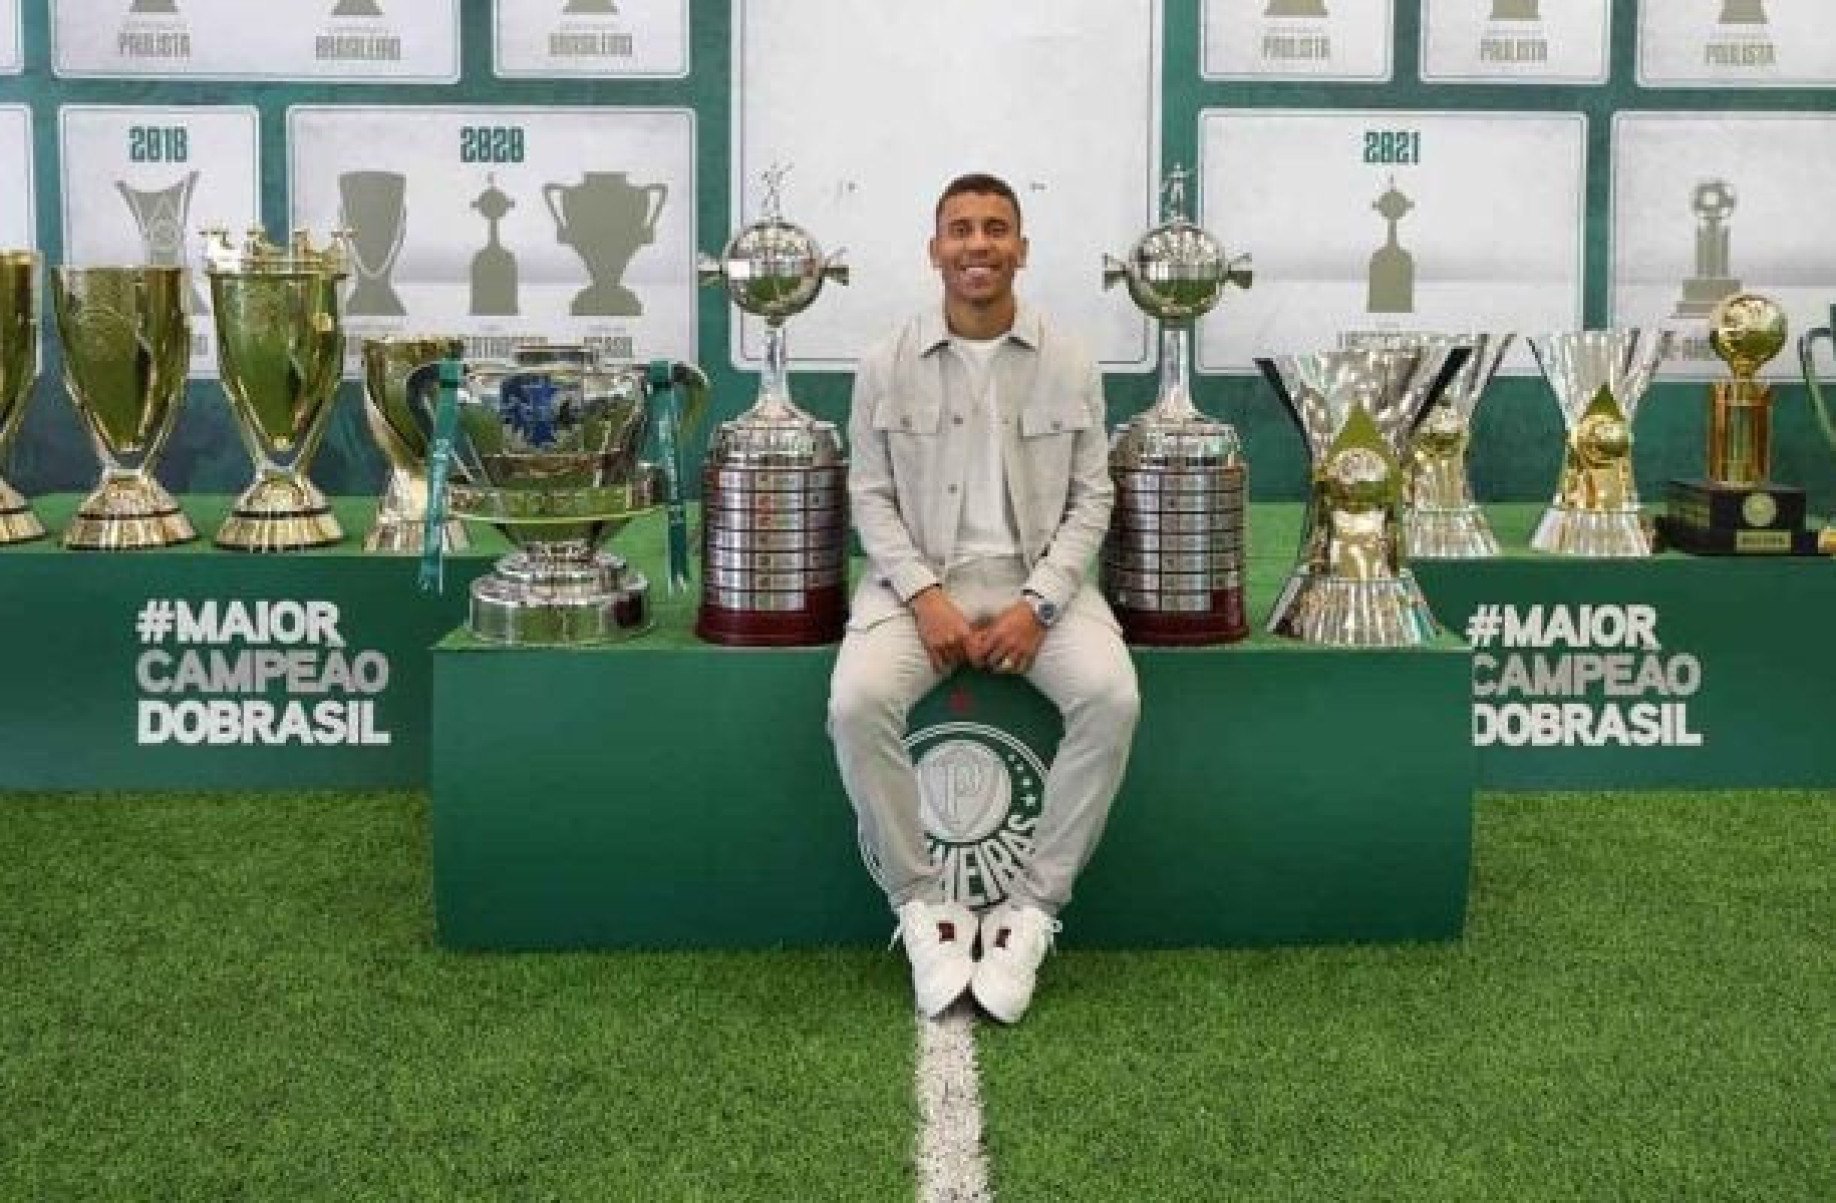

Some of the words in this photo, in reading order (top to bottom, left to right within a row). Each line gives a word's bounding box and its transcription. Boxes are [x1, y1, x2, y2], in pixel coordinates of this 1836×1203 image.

[129, 126, 187, 163] 2018
[460, 126, 524, 163] 2020
[1363, 129, 1421, 165] 2021
[135, 599, 346, 647] #MAIOR
[1466, 603, 1662, 650] #MAIOR
[137, 700, 392, 746] DOBRASIL
[1472, 703, 1703, 747] DOBRASIL
